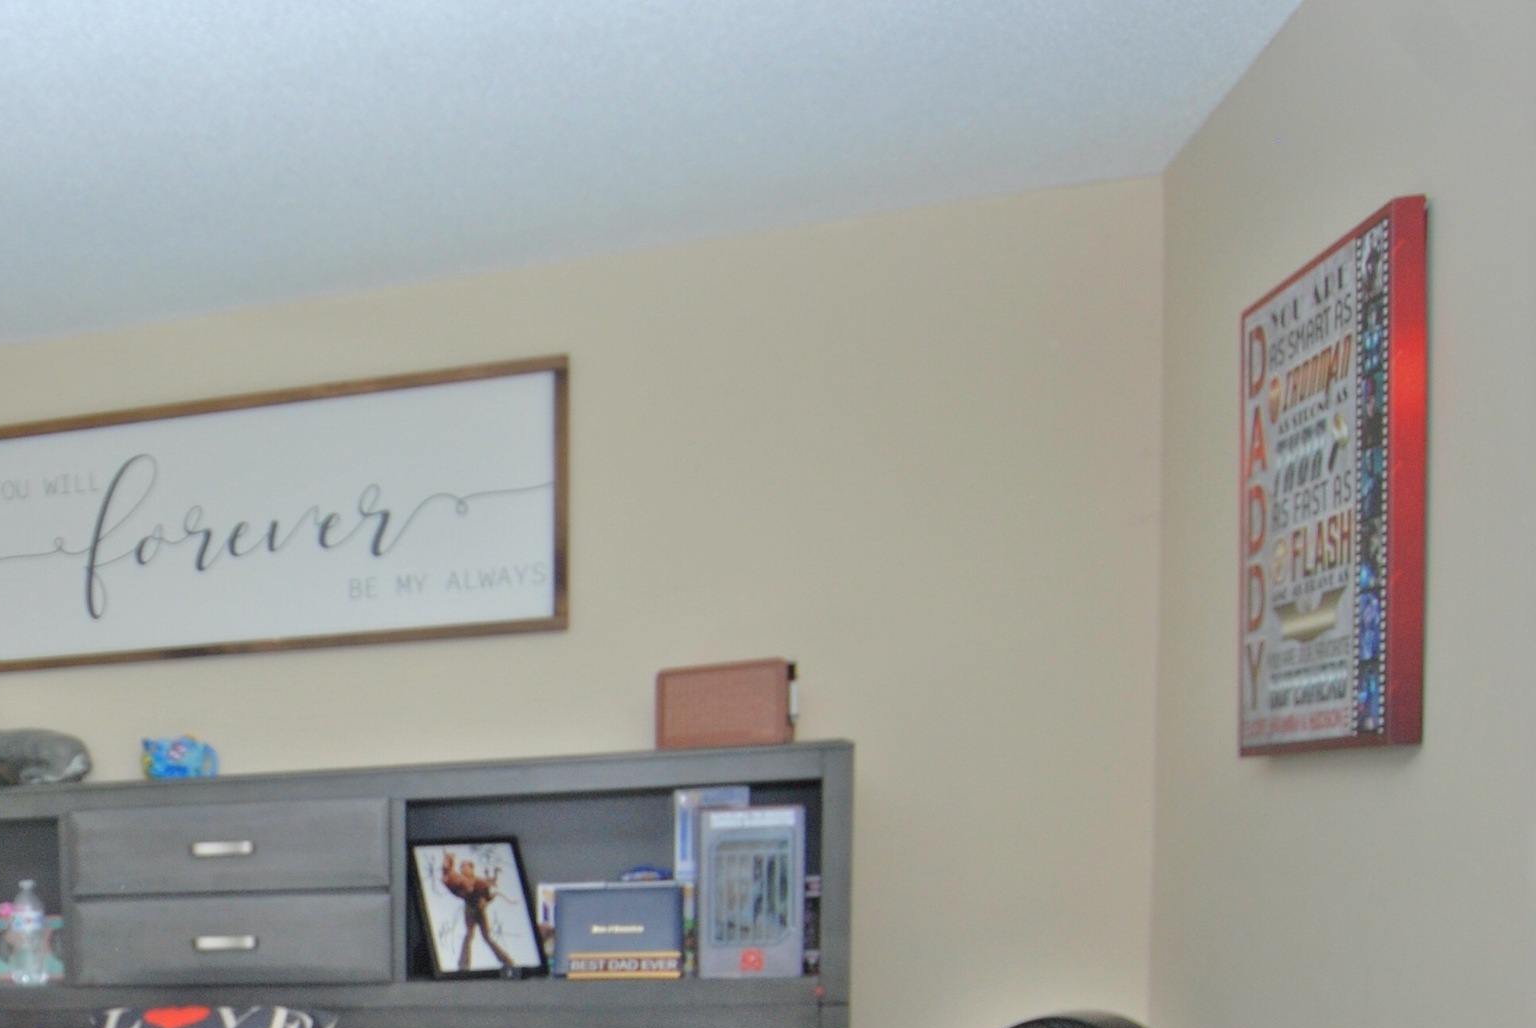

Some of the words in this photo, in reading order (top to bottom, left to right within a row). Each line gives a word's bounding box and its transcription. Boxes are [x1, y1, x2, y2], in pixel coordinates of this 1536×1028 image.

[1270, 295, 1298, 328] YOU
[1313, 264, 1345, 304] ARE
[1269, 336, 1284, 368] AS
[1288, 305, 1330, 360] SMART
[1334, 292, 1352, 330] AS
[43, 472, 101, 495] WILL
[1271, 497, 1288, 532] AS
[1293, 480, 1328, 522] FAST
[1333, 469, 1352, 507] AS
[52, 454, 469, 620] forever
[1292, 508, 1351, 580] FLASH
[348, 577, 378, 599] BE
[395, 573, 427, 595] MY
[447, 562, 548, 591] ALWAYS
[570, 958, 606, 972] BEST
[608, 958, 639, 972] DAD
[642, 957, 679, 972] EVER
